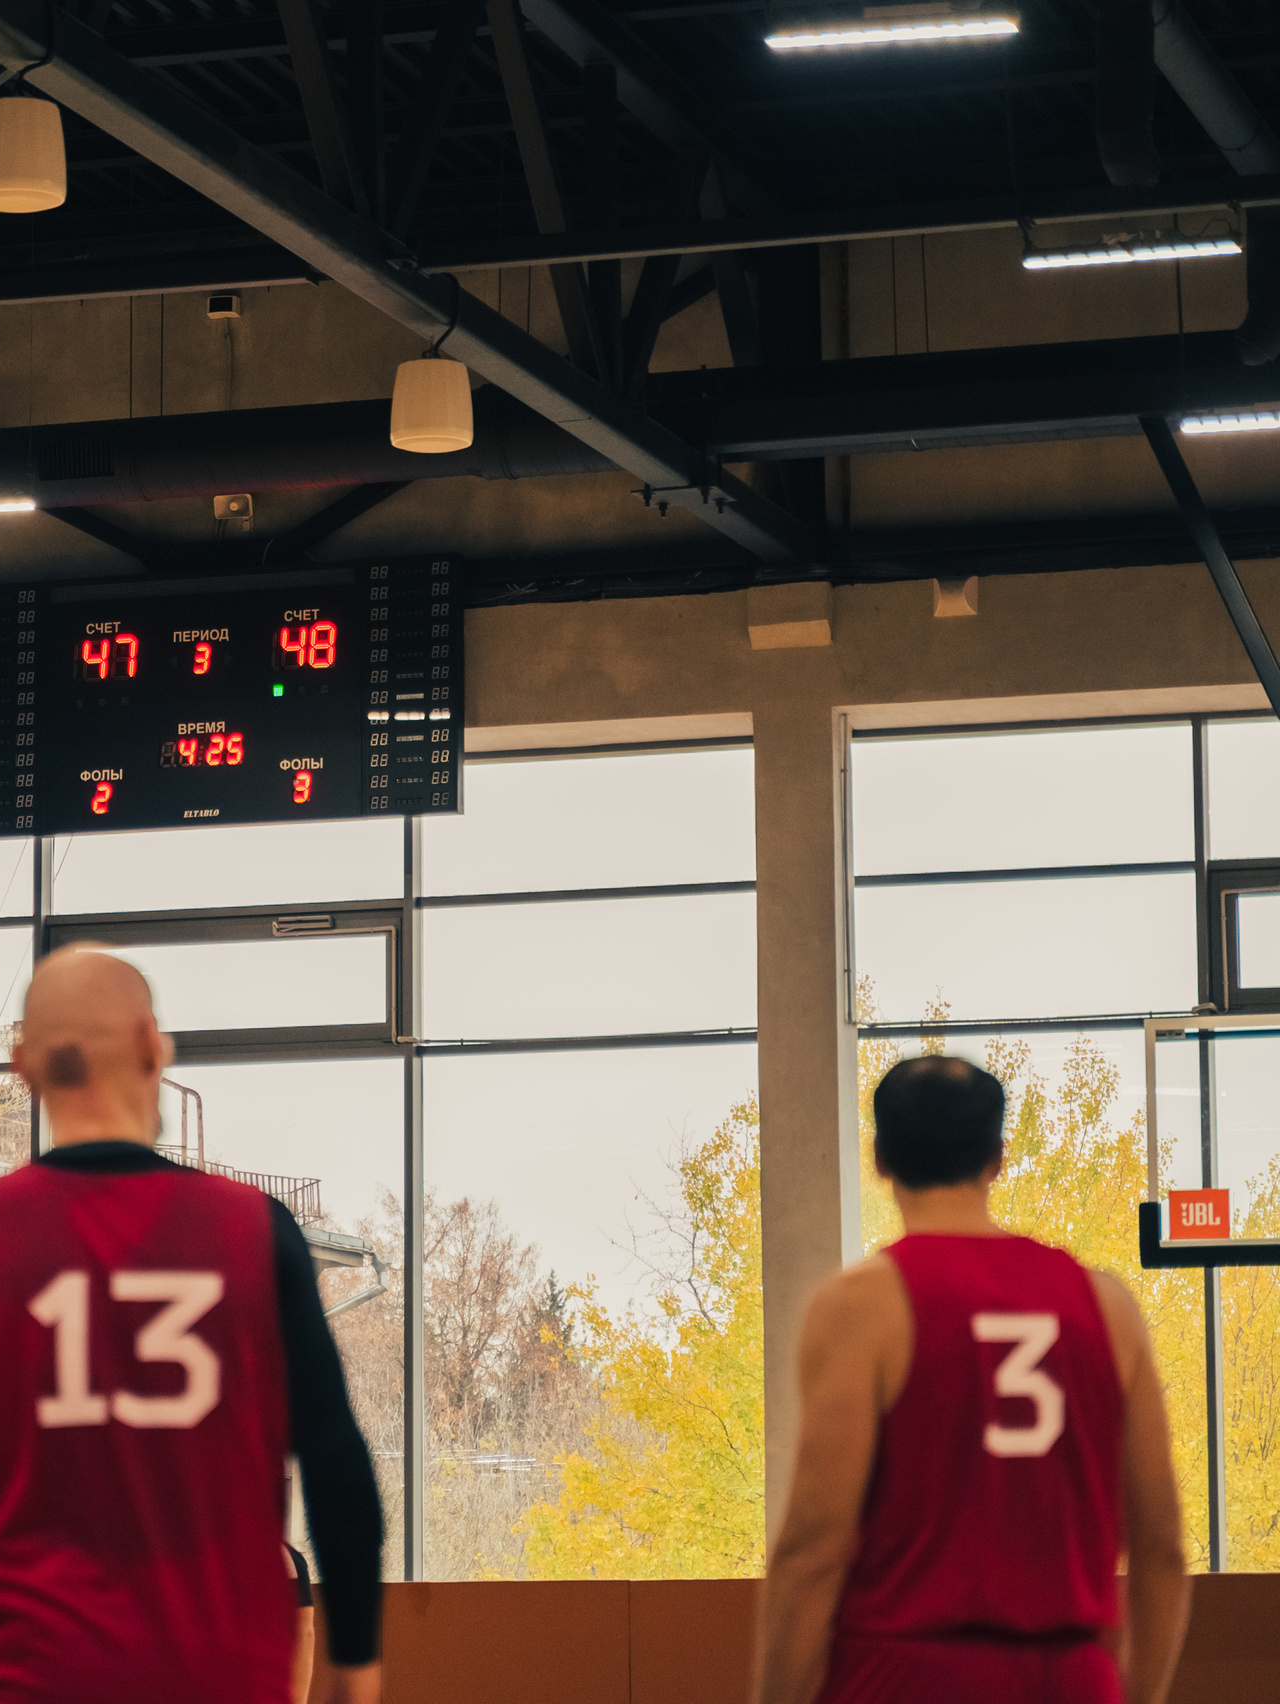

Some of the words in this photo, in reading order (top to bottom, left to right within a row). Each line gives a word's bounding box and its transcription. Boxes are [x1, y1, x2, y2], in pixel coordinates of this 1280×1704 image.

[284, 609, 320, 622] СЧЕТ
[86, 622, 121, 634] СЧЕТ
[173, 628, 229, 643] ПЕРИОД
[280, 621, 337, 669] 48
[83, 635, 139, 679] 47
[194, 644, 212, 674] 3
[178, 721, 226, 735] ВРЕМЯ
[280, 757, 323, 771] ФОЛЫ
[80, 769, 123, 782] ФОЛЫ
[91, 782, 112, 814] 2
[183, 809, 220, 818] ELTABLO
[1181, 1202, 1220, 1226] JBL
[27, 1270, 224, 1429] 13
[971, 1313, 1065, 1457] 3
